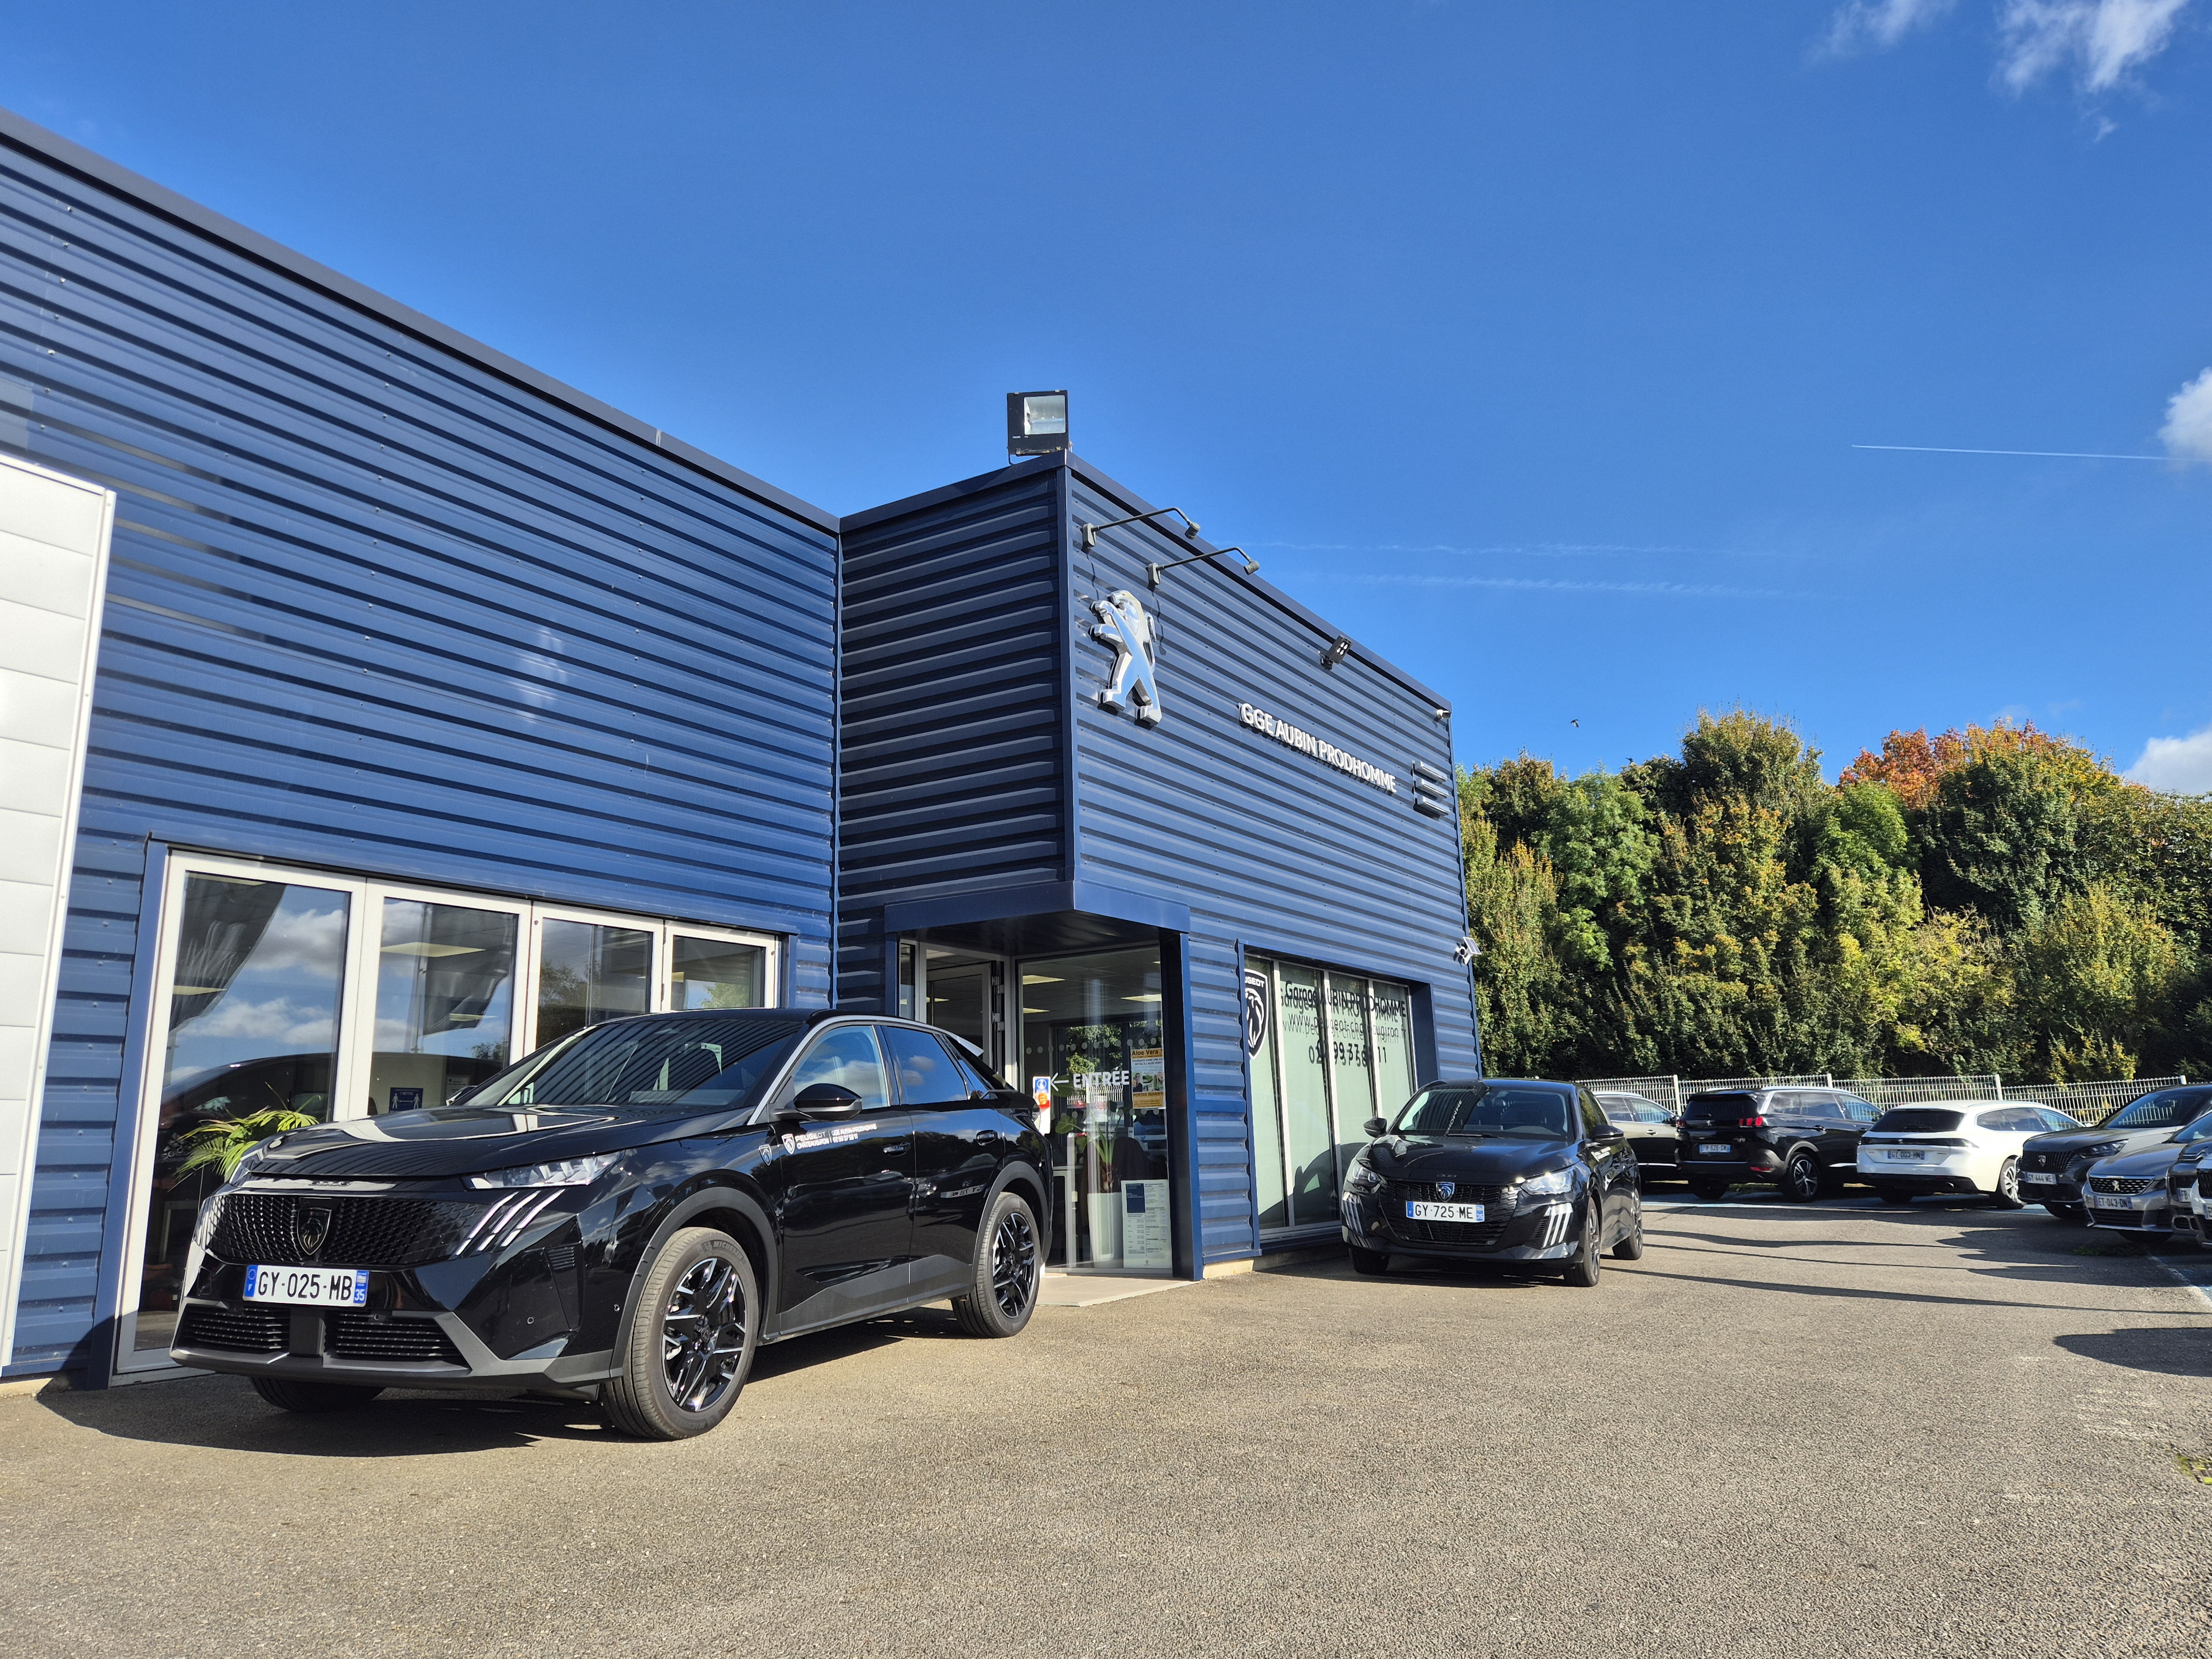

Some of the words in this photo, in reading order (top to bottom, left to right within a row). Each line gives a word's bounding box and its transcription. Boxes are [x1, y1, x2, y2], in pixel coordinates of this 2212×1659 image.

[1240, 703, 1274, 736] GGE
[1276, 719, 1316, 755] AUBIN
[1318, 739, 1397, 793] PRODHOMME
[1073, 1066, 1130, 1088] ENTRÉE
[795, 1131, 826, 1142] PEUGEOT
[1415, 1204, 1473, 1219] GY-725-ME
[713, 1240, 744, 1261] MICHELIN
[258, 1271, 353, 1301] GY-025-MB
[354, 1288, 365, 1301] 35
